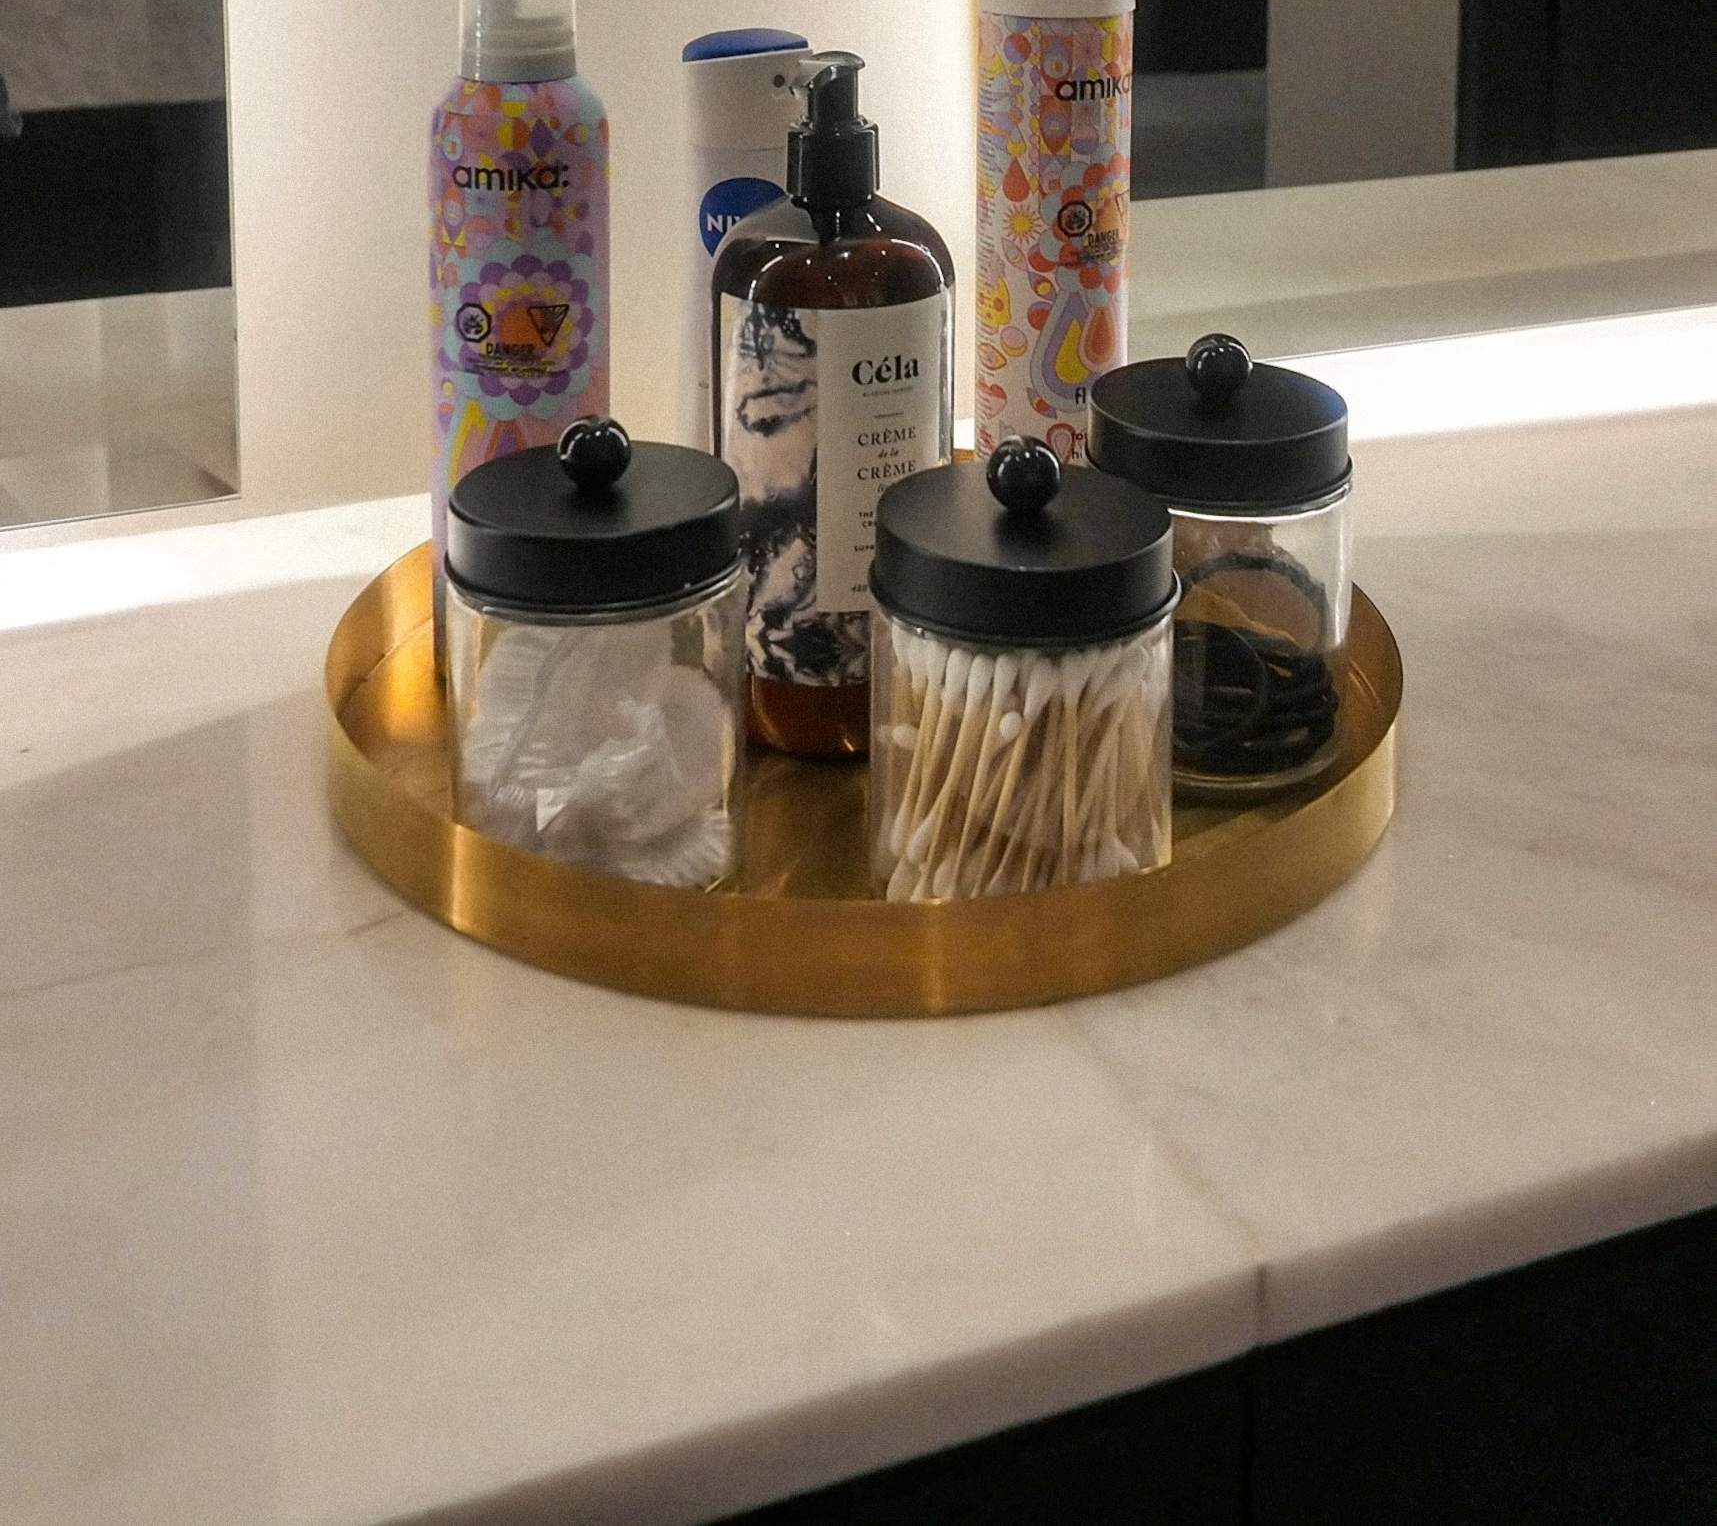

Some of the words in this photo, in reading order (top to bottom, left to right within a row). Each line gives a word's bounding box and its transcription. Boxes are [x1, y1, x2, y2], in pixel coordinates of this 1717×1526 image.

[851, 354, 920, 386] Céla
[857, 426, 917, 447] CRÈME
[856, 460, 917, 481] CRÈME
